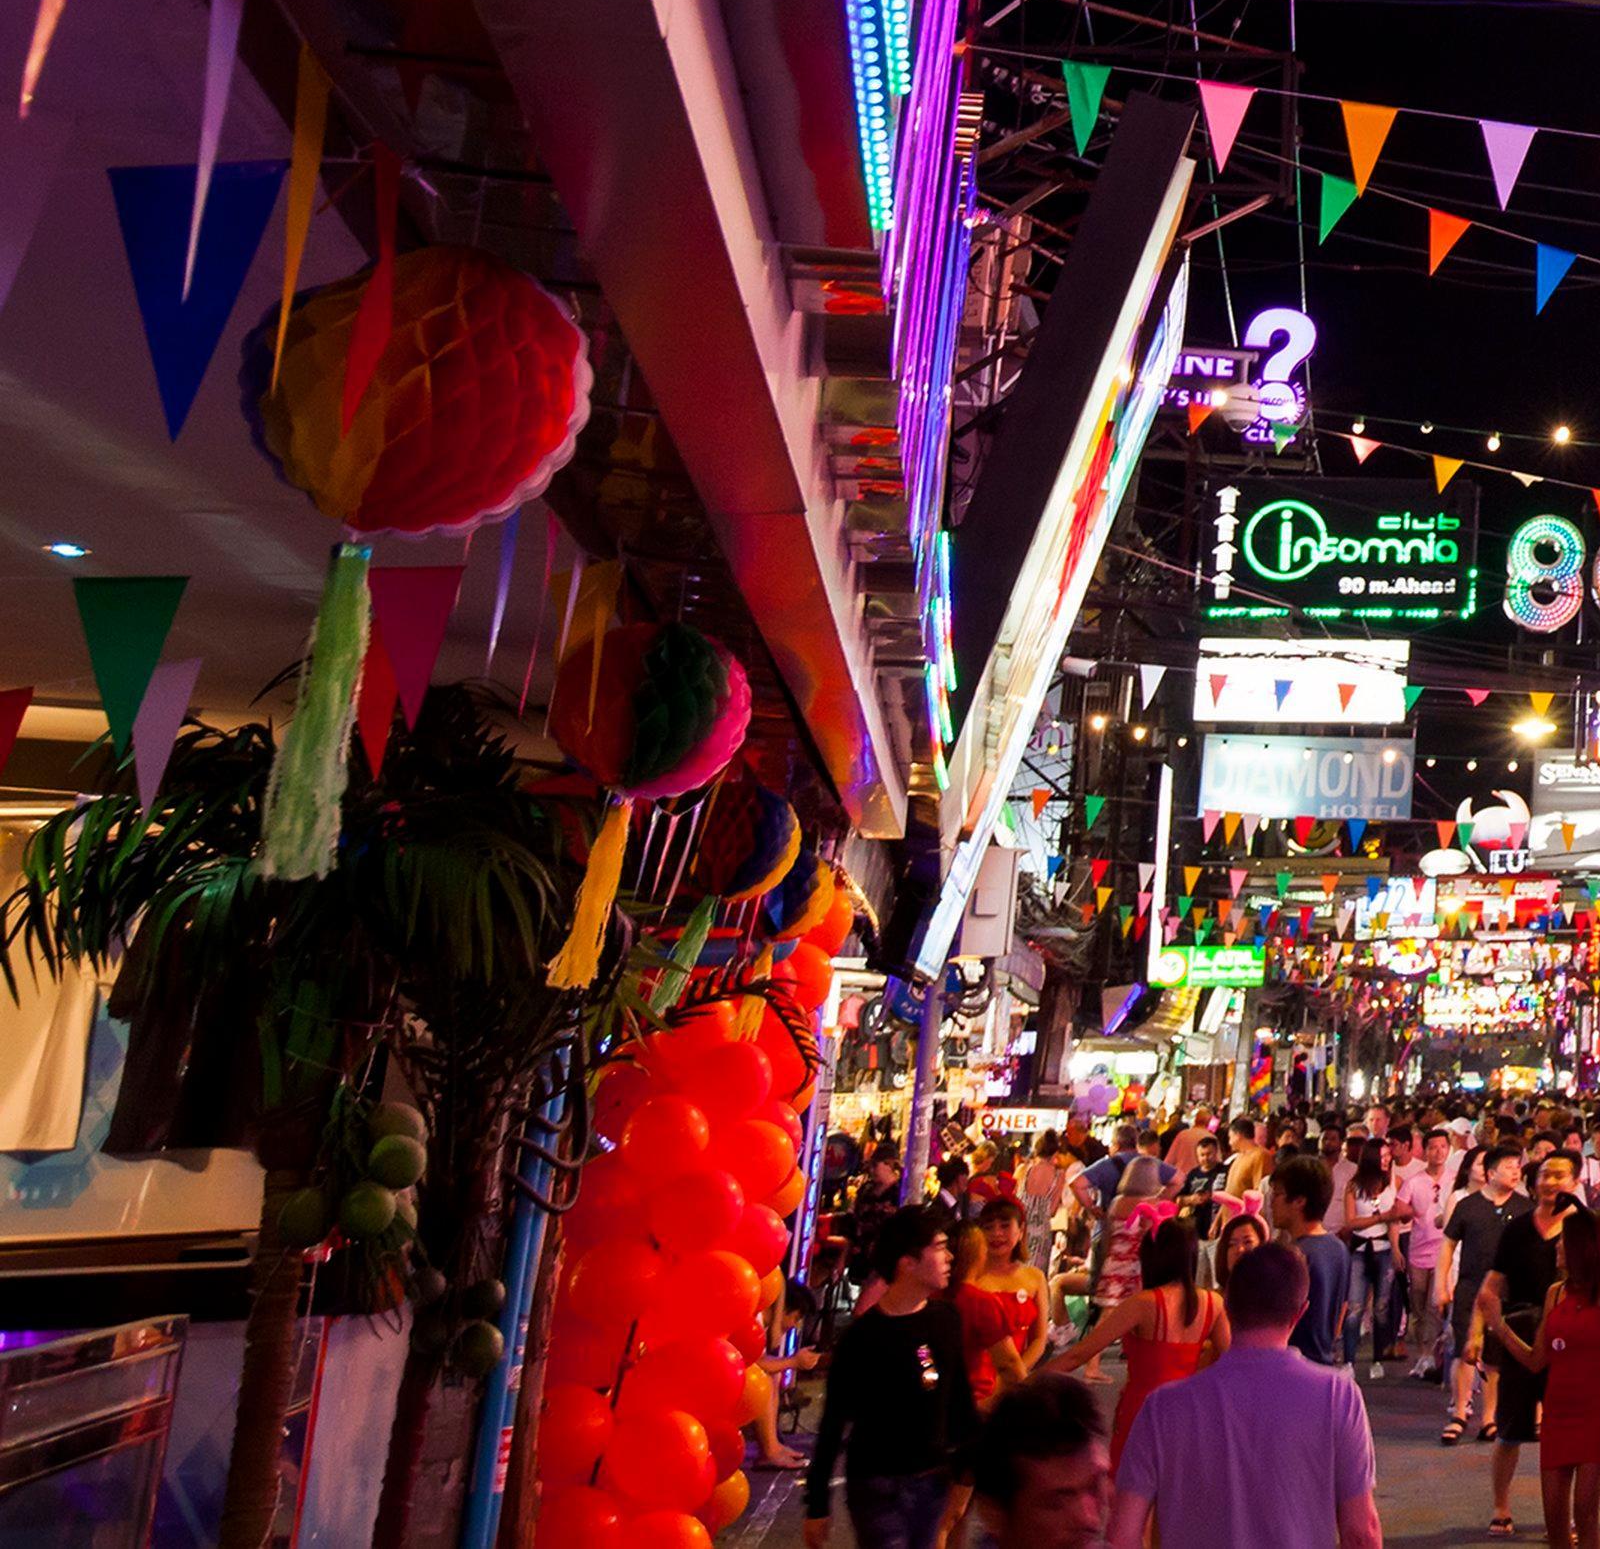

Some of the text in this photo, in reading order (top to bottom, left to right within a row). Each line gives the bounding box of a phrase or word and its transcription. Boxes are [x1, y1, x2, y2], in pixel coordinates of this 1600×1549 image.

[1377, 511, 1461, 531] club
[1279, 508, 1459, 572] insomnia
[1338, 576, 1365, 594] 90
[1205, 748, 1413, 800] DIAMOND
[1319, 804, 1399, 818] HOTEL
